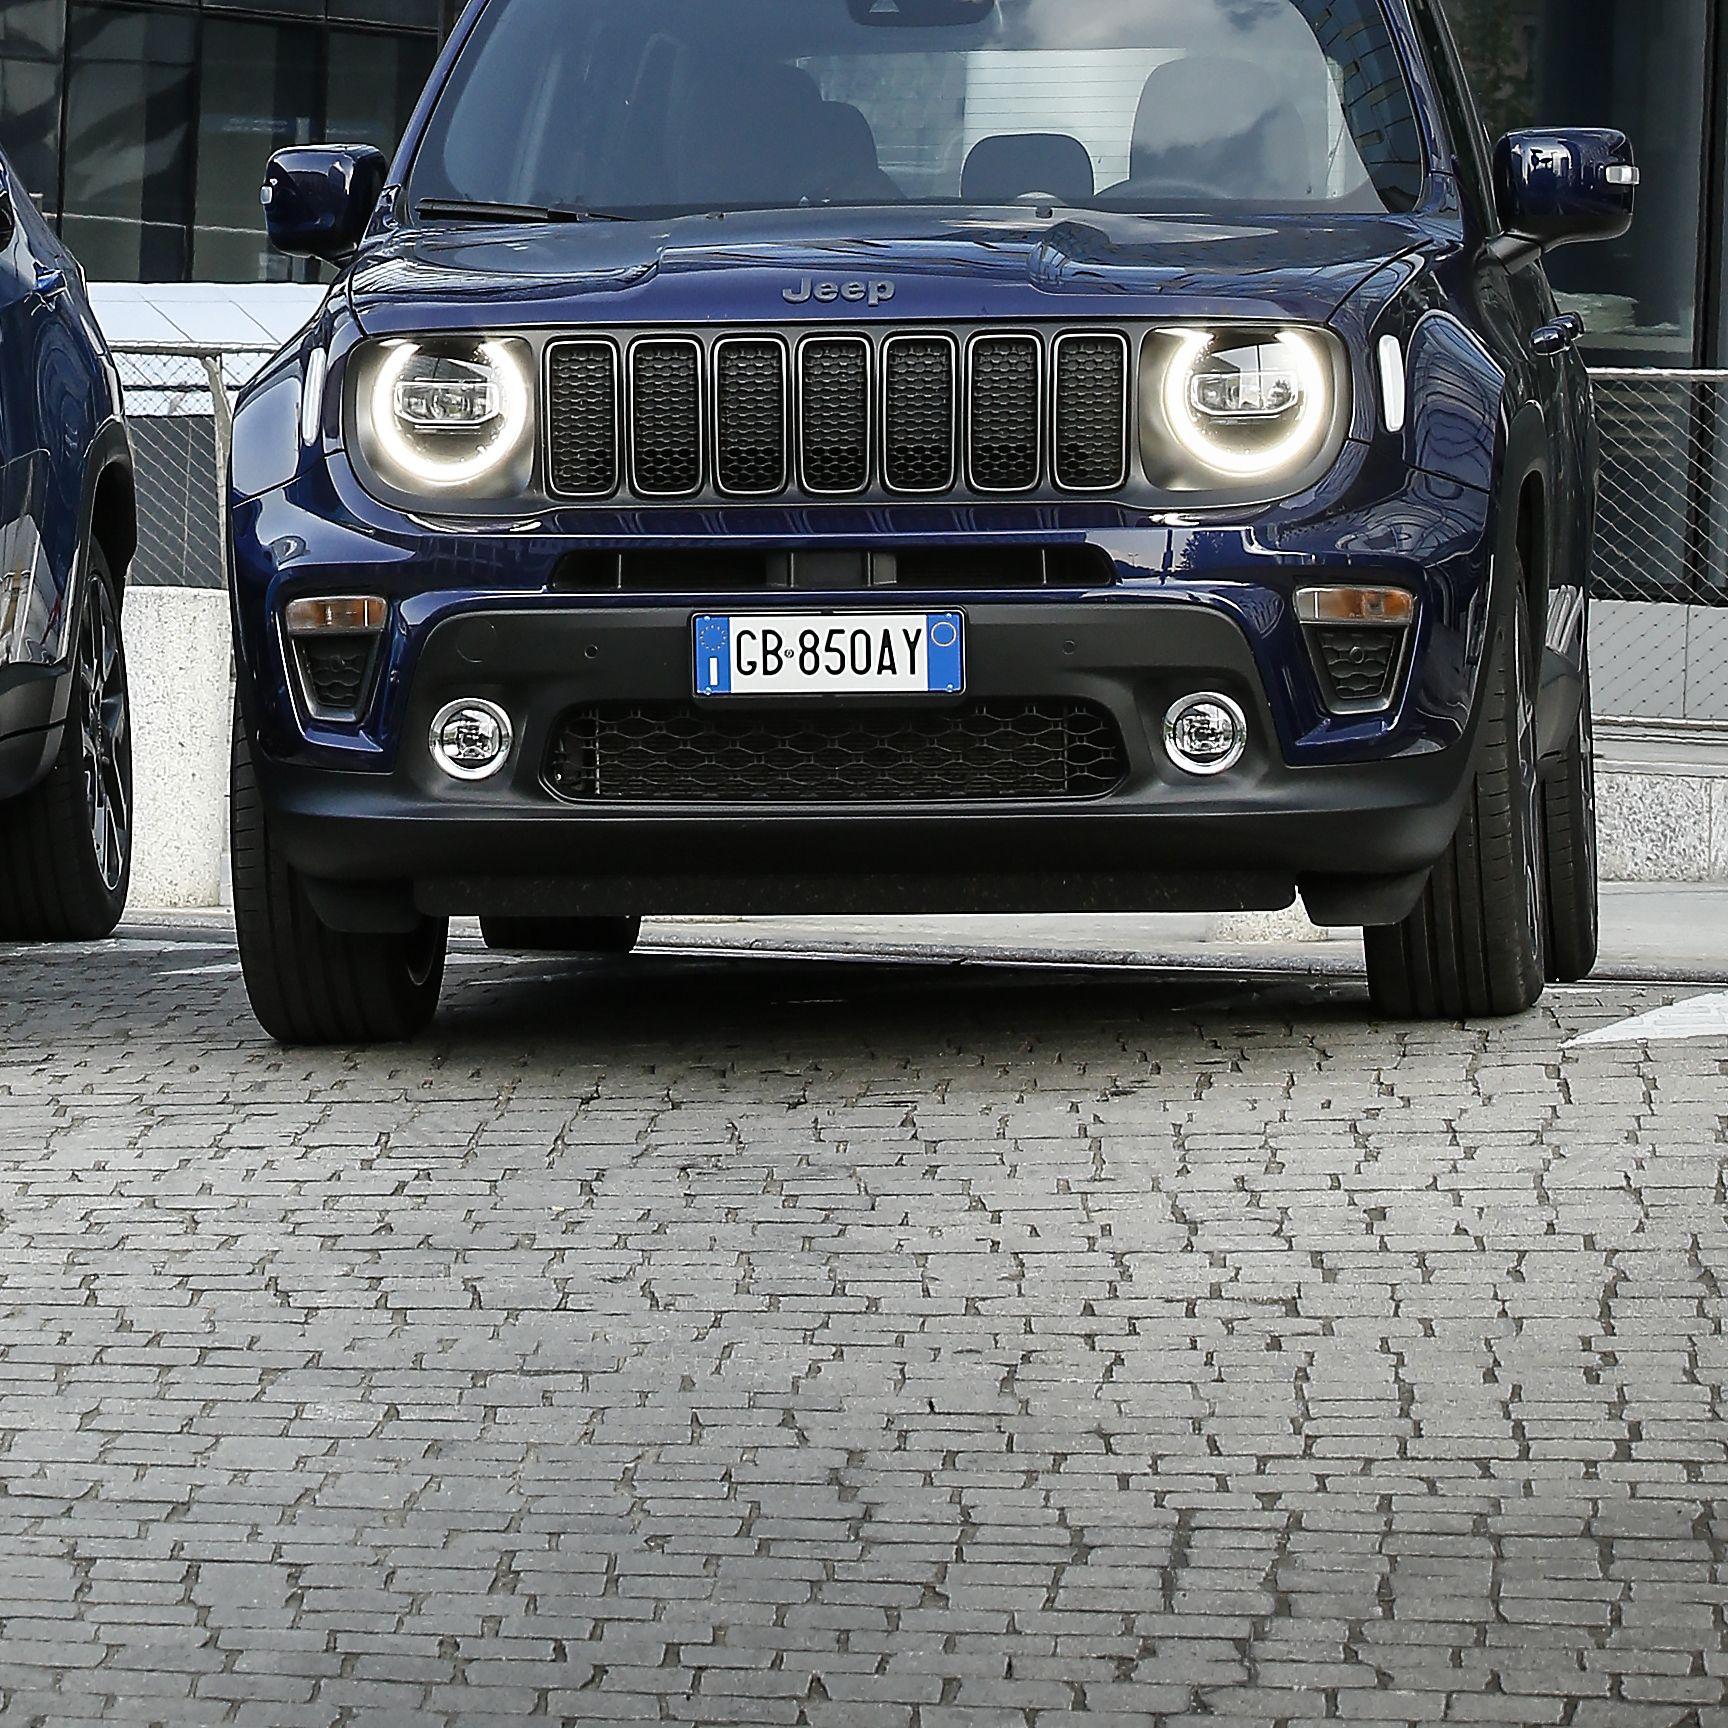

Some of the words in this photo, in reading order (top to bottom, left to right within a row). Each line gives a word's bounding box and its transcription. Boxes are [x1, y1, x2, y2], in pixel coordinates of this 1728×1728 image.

[781, 276, 896, 308] Jeep
[735, 628, 784, 676] GB
[797, 628, 923, 676] 850AY
